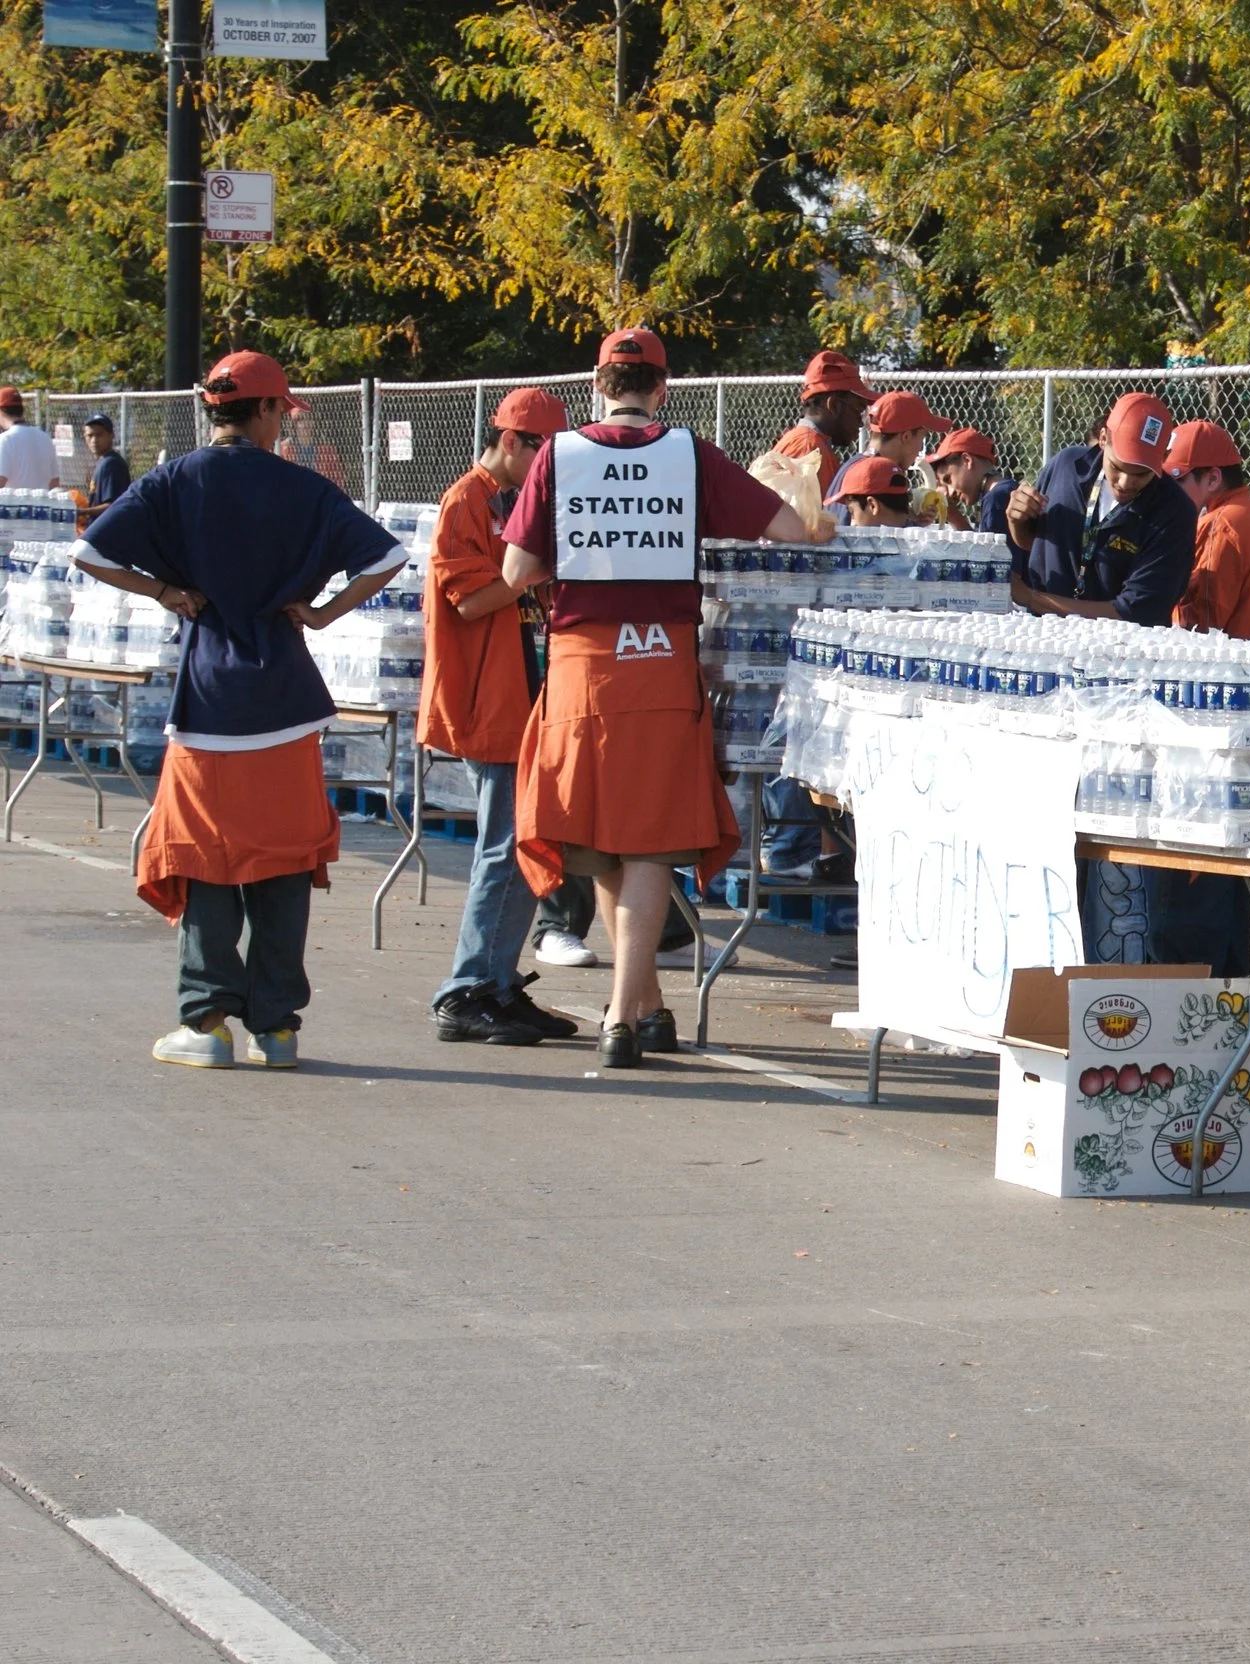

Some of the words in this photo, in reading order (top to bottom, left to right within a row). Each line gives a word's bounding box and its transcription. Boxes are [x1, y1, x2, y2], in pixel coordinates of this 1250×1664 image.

[223, 17, 233, 26] 30
[235, 18, 258, 27] Years
[260, 19, 269, 28] of
[271, 20, 316, 30] Inspiration
[223, 29, 270, 42] OCTOBER
[273, 32, 289, 44] 07,
[292, 33, 316, 43] 2007
[210, 230, 233, 239] TOW
[238, 231, 267, 240] ZONE
[603, 463, 648, 480] AID
[568, 497, 683, 514] STATION
[568, 531, 684, 548] CAPTAIN
[616, 623, 671, 653] AA
[1174, 1118, 1222, 1133] ornic
